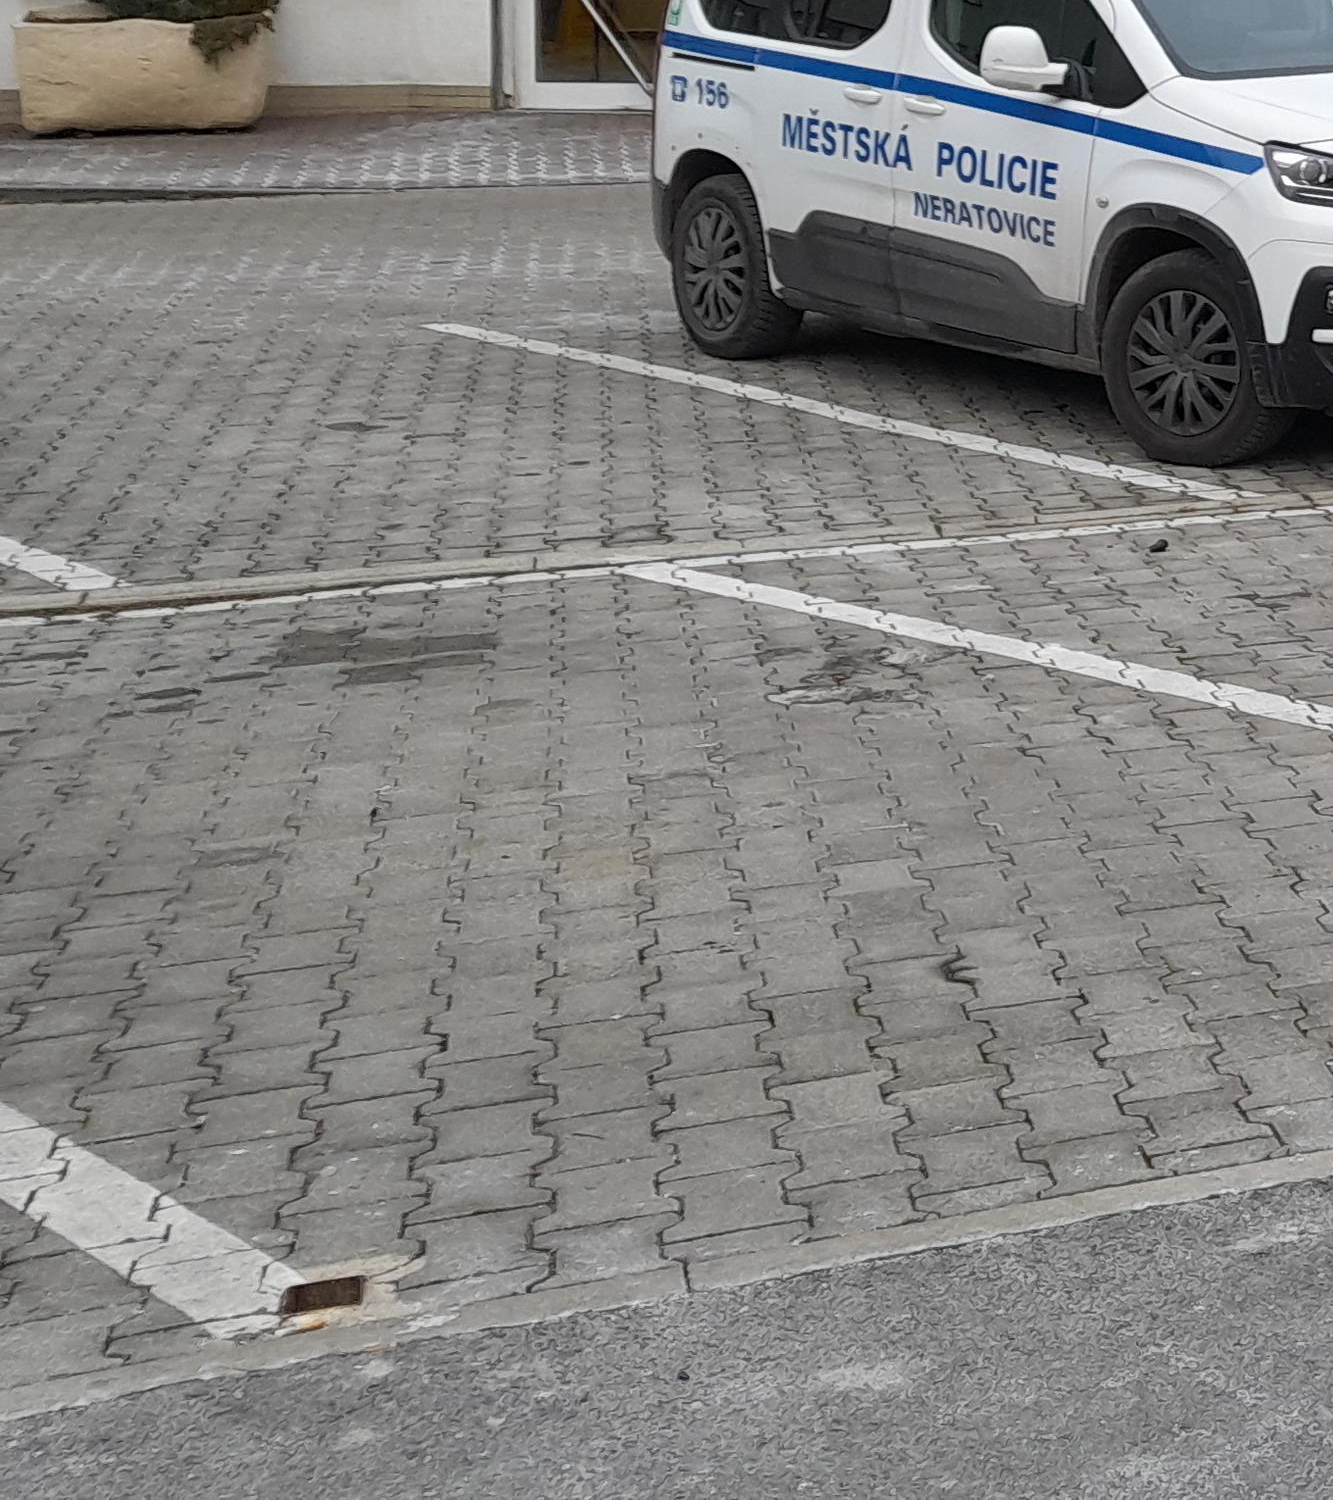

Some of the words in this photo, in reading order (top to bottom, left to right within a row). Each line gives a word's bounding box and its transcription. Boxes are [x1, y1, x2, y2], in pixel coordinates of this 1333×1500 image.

[695, 78, 729, 109] 156
[782, 109, 913, 171] MĚSTSKÁ
[936, 141, 1060, 200] POLICIE
[913, 191, 1057, 248] NERATOVICE
